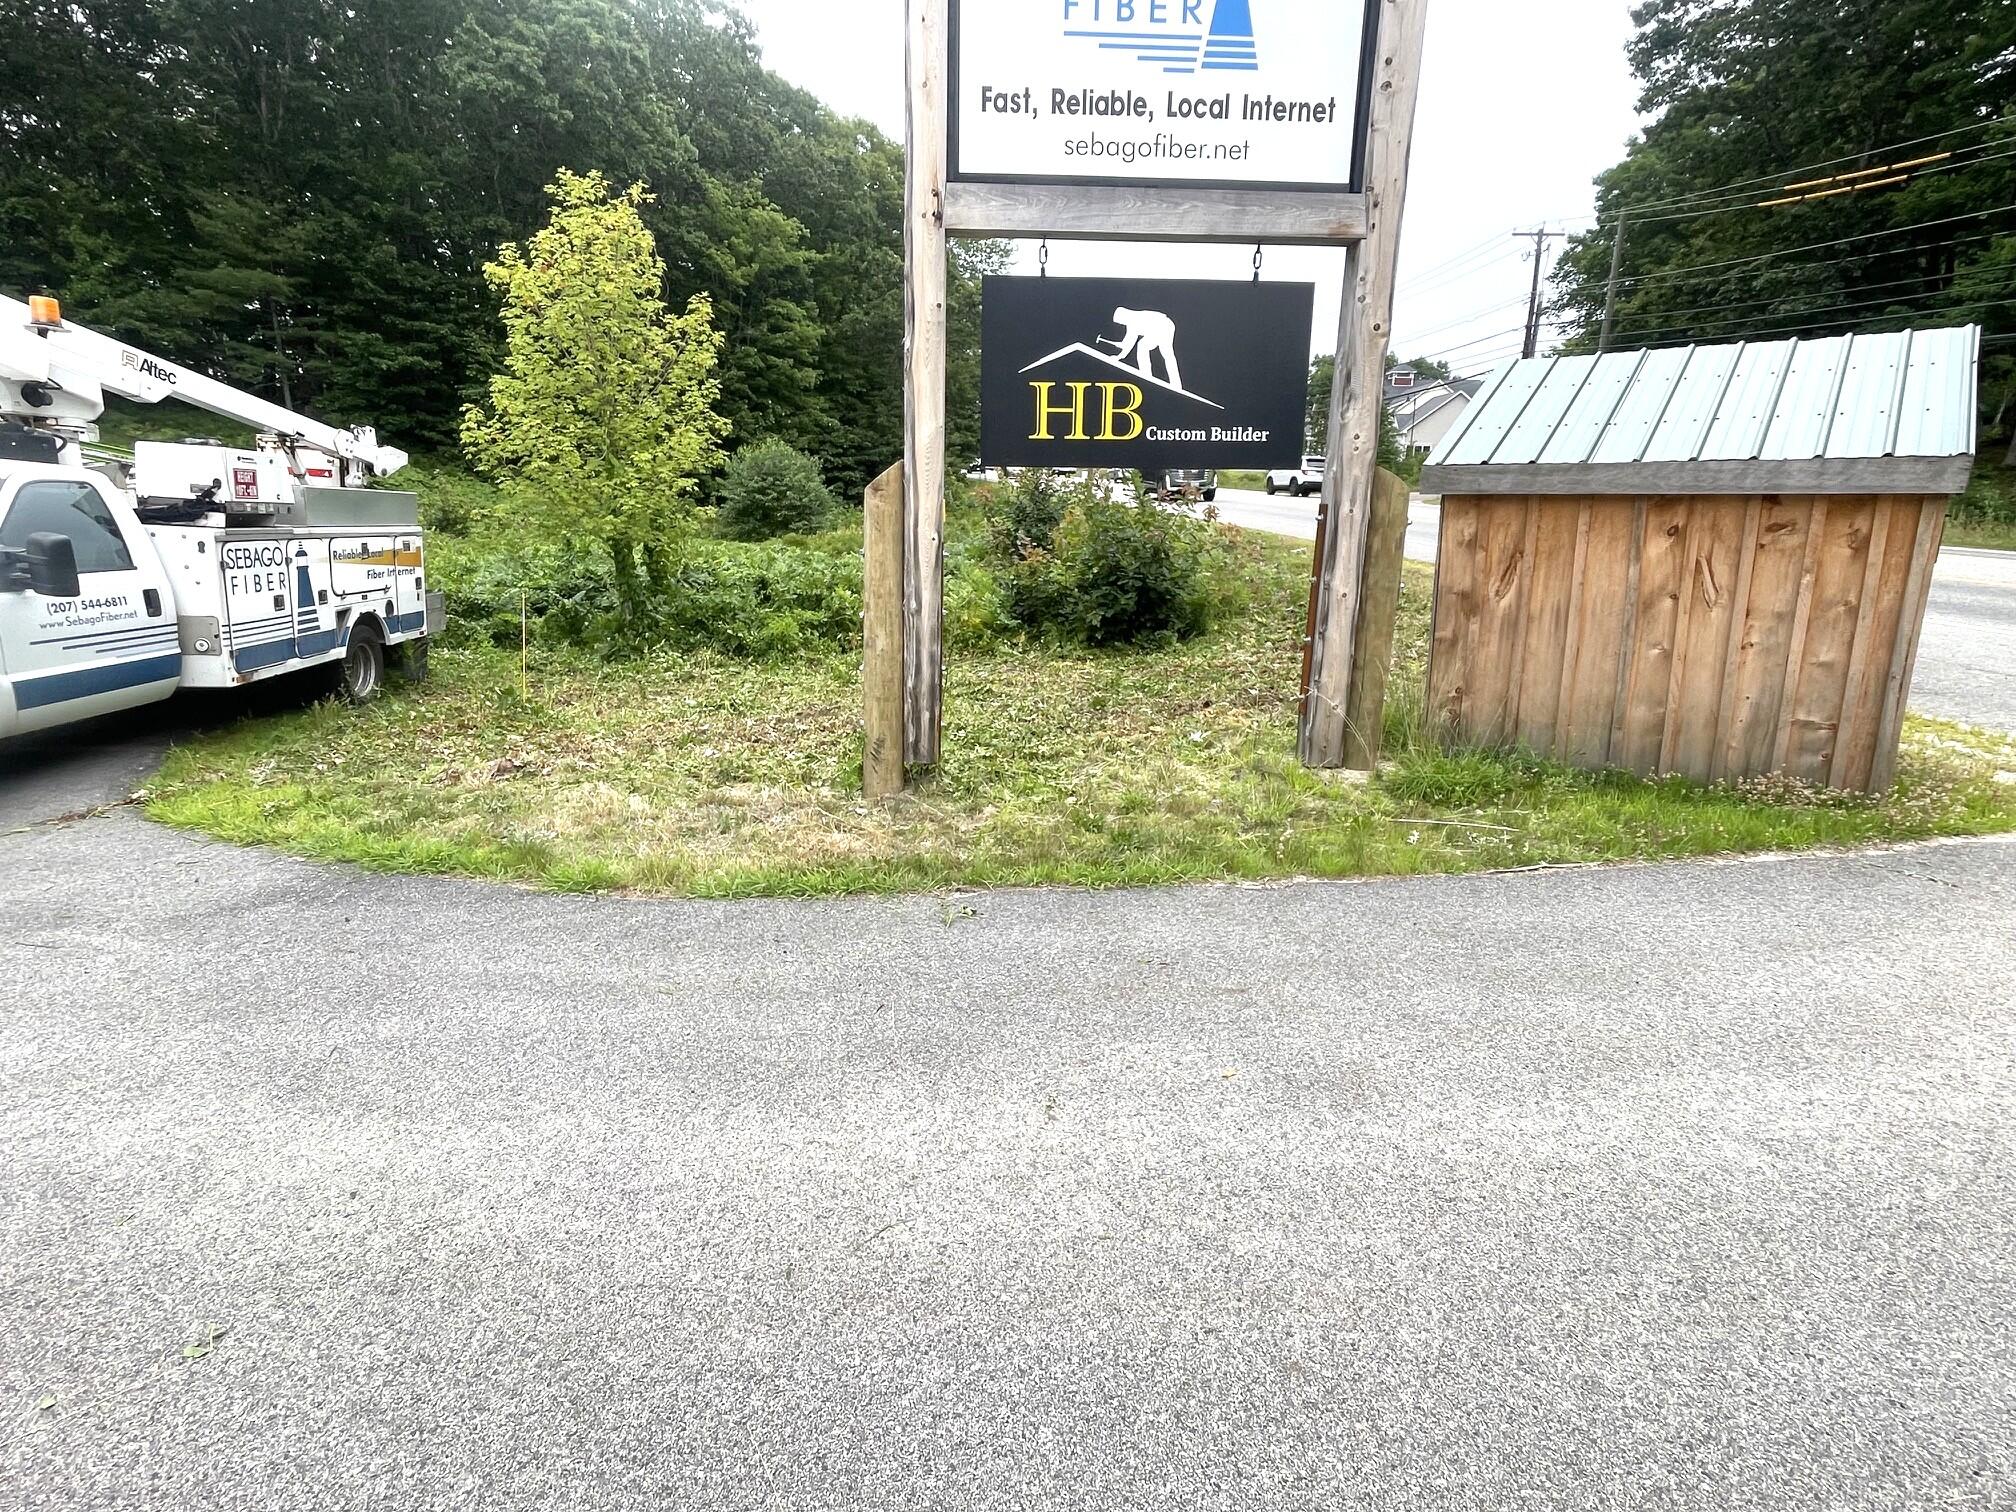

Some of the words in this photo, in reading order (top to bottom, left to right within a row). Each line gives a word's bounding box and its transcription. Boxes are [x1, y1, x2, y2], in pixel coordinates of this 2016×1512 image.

[1064, 0, 1202, 24] FIBER
[981, 86, 1038, 119] Fast,
[1051, 88, 1154, 122] Reliable,
[1166, 90, 1231, 120] Local
[1242, 94, 1337, 123] Internet
[1063, 131, 1251, 163] sebagofiber.net
[139, 358, 177, 385] Altec
[1028, 381, 1144, 441] HB
[1145, 425, 1207, 443] Custom
[1211, 426, 1270, 443] Builder
[226, 546, 284, 570] SEBAGO
[231, 572, 287, 596] FIBER
[367, 568, 385, 580] Fiber
[46, 601, 78, 616] (207)
[81, 596, 128, 611] 544-6811
